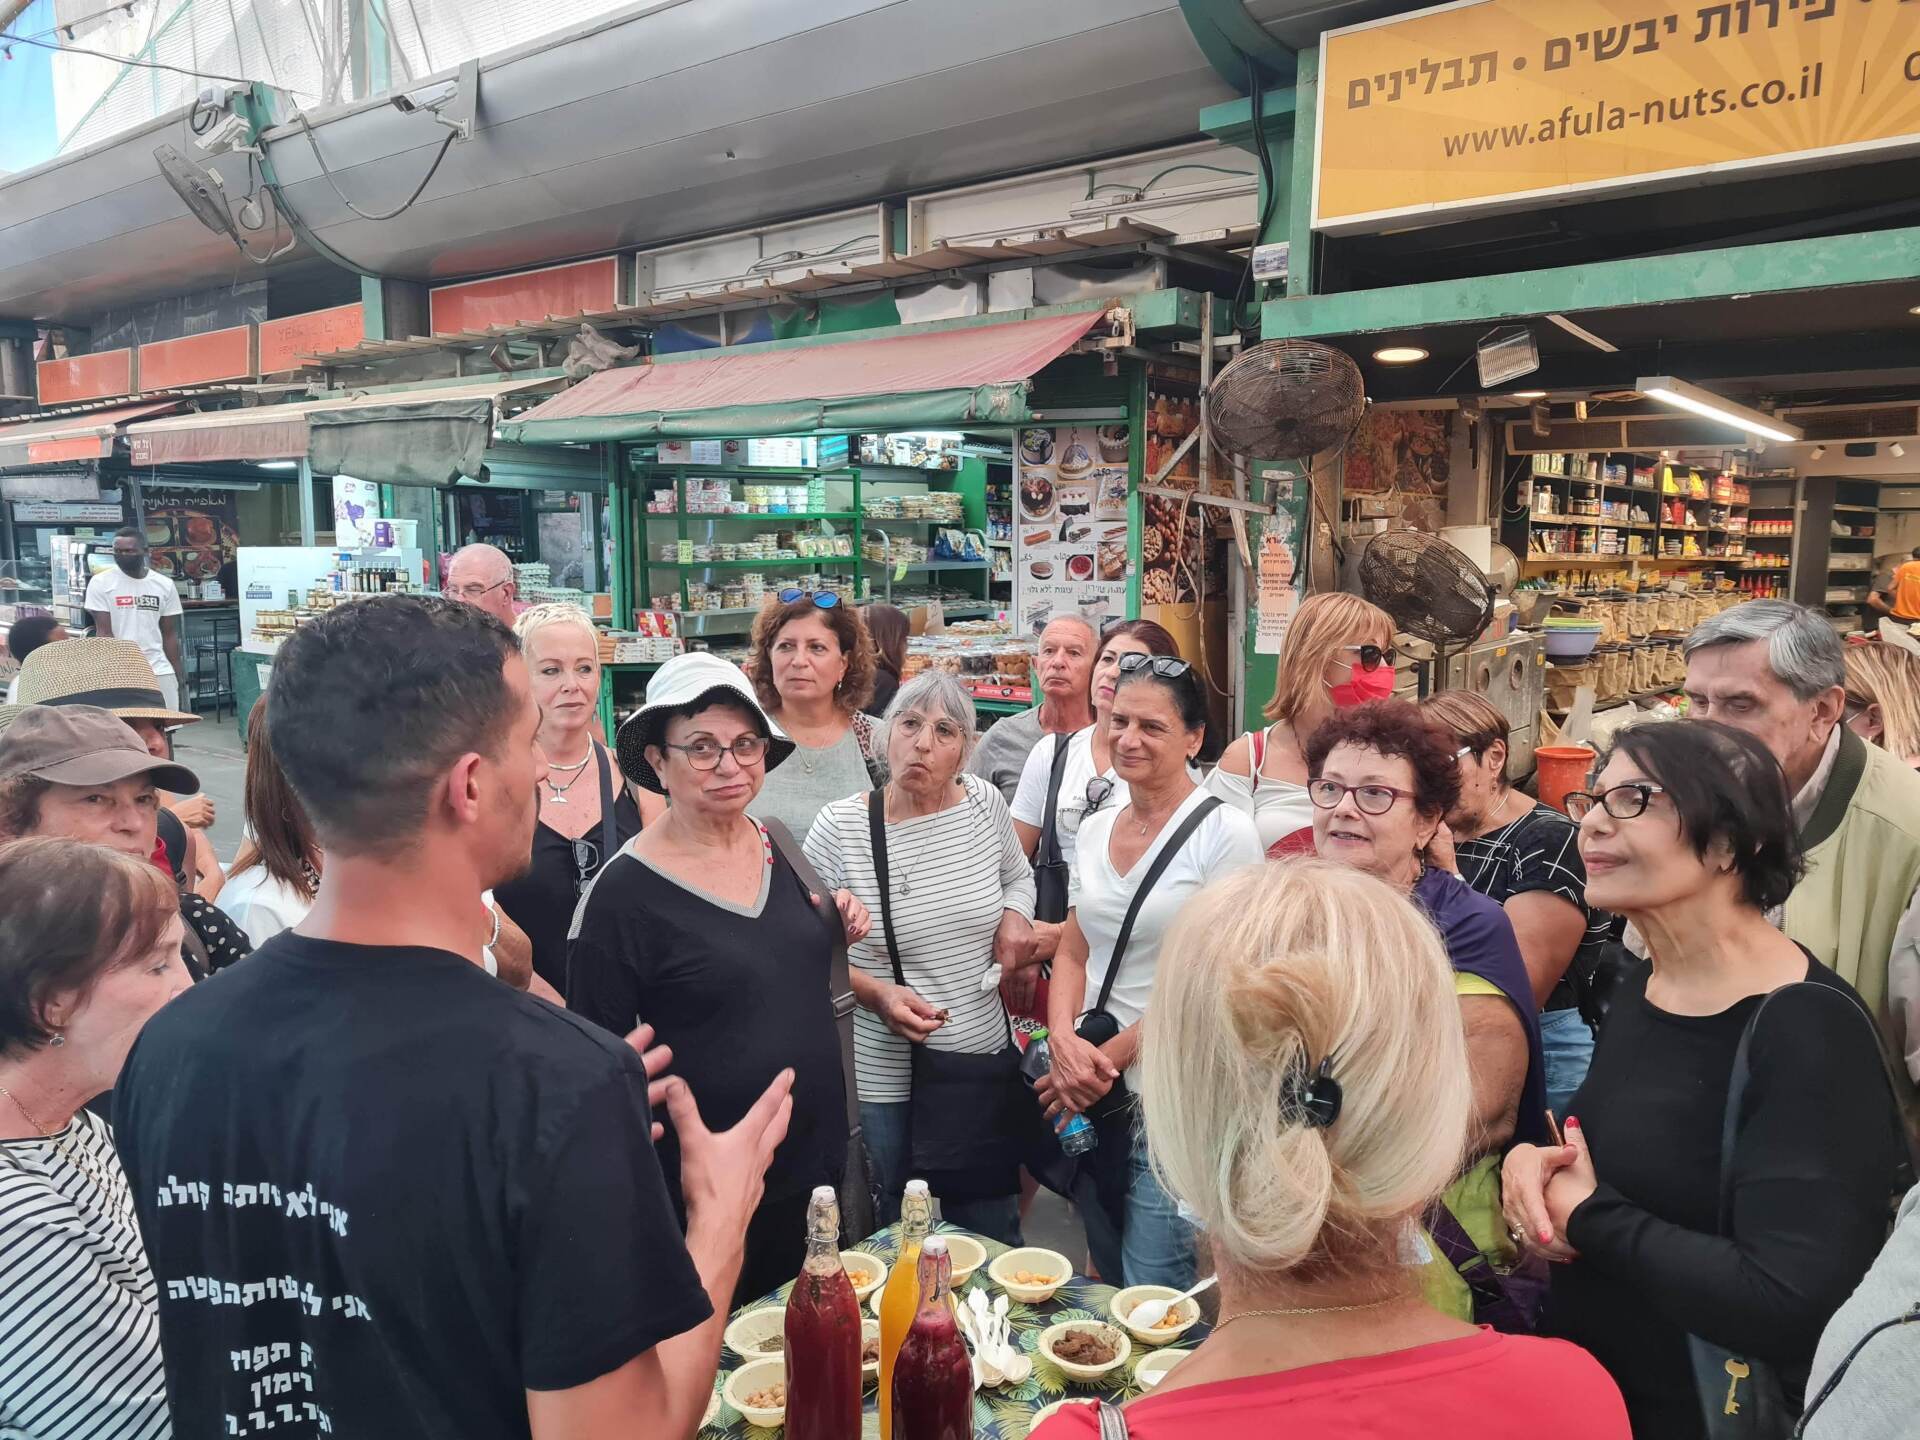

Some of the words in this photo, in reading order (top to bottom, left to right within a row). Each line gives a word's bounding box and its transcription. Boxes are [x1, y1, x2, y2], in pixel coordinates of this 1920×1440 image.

[1544, 14, 1678, 72] יבשים
[1347, 50, 1499, 110] תבלינים
[1443, 62, 1823, 158] www.afula-nuts.co.il
[157, 1174, 210, 1211] קולה
[285, 1182, 317, 1218] לא
[332, 1294, 372, 1321] אני
[230, 1342, 291, 1373] תפוז
[250, 1372, 314, 1409] רימון
